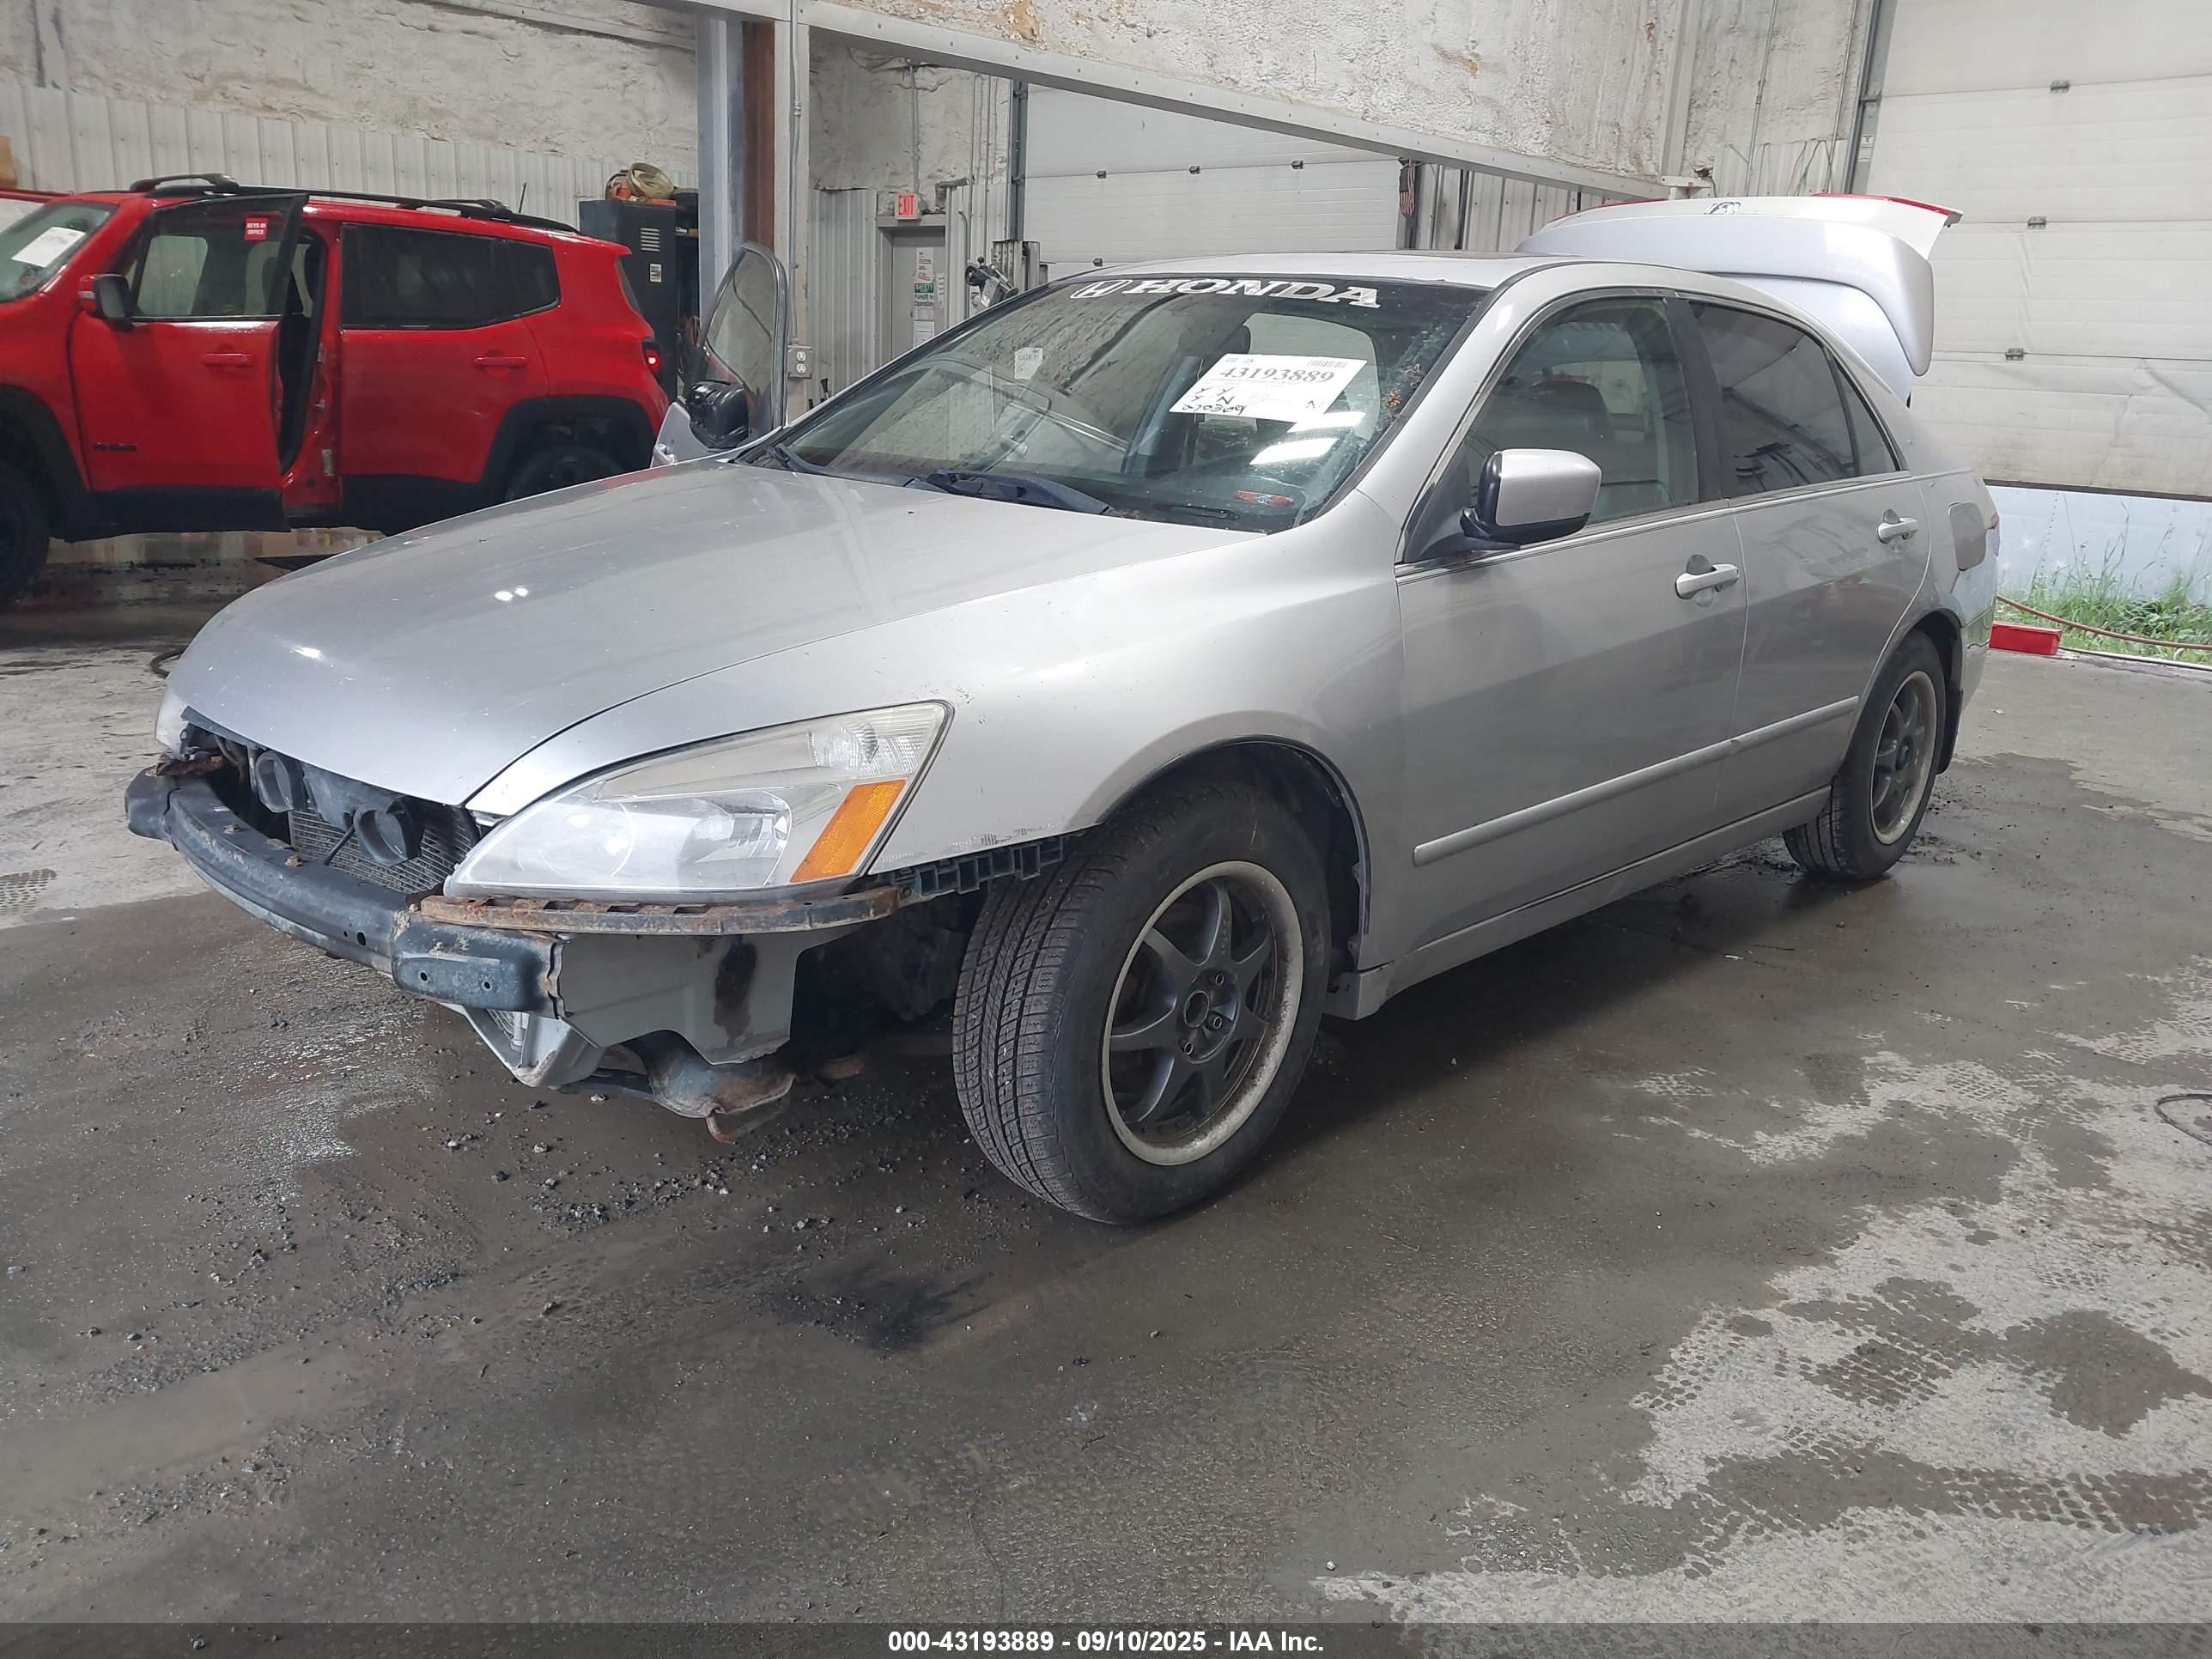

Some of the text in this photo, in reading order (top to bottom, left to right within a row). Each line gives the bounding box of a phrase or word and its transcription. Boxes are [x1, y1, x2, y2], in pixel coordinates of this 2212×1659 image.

[898, 195, 914, 216] EXIT
[1121, 278, 1382, 309] HONDA
[1220, 367, 1334, 383] 43193889
